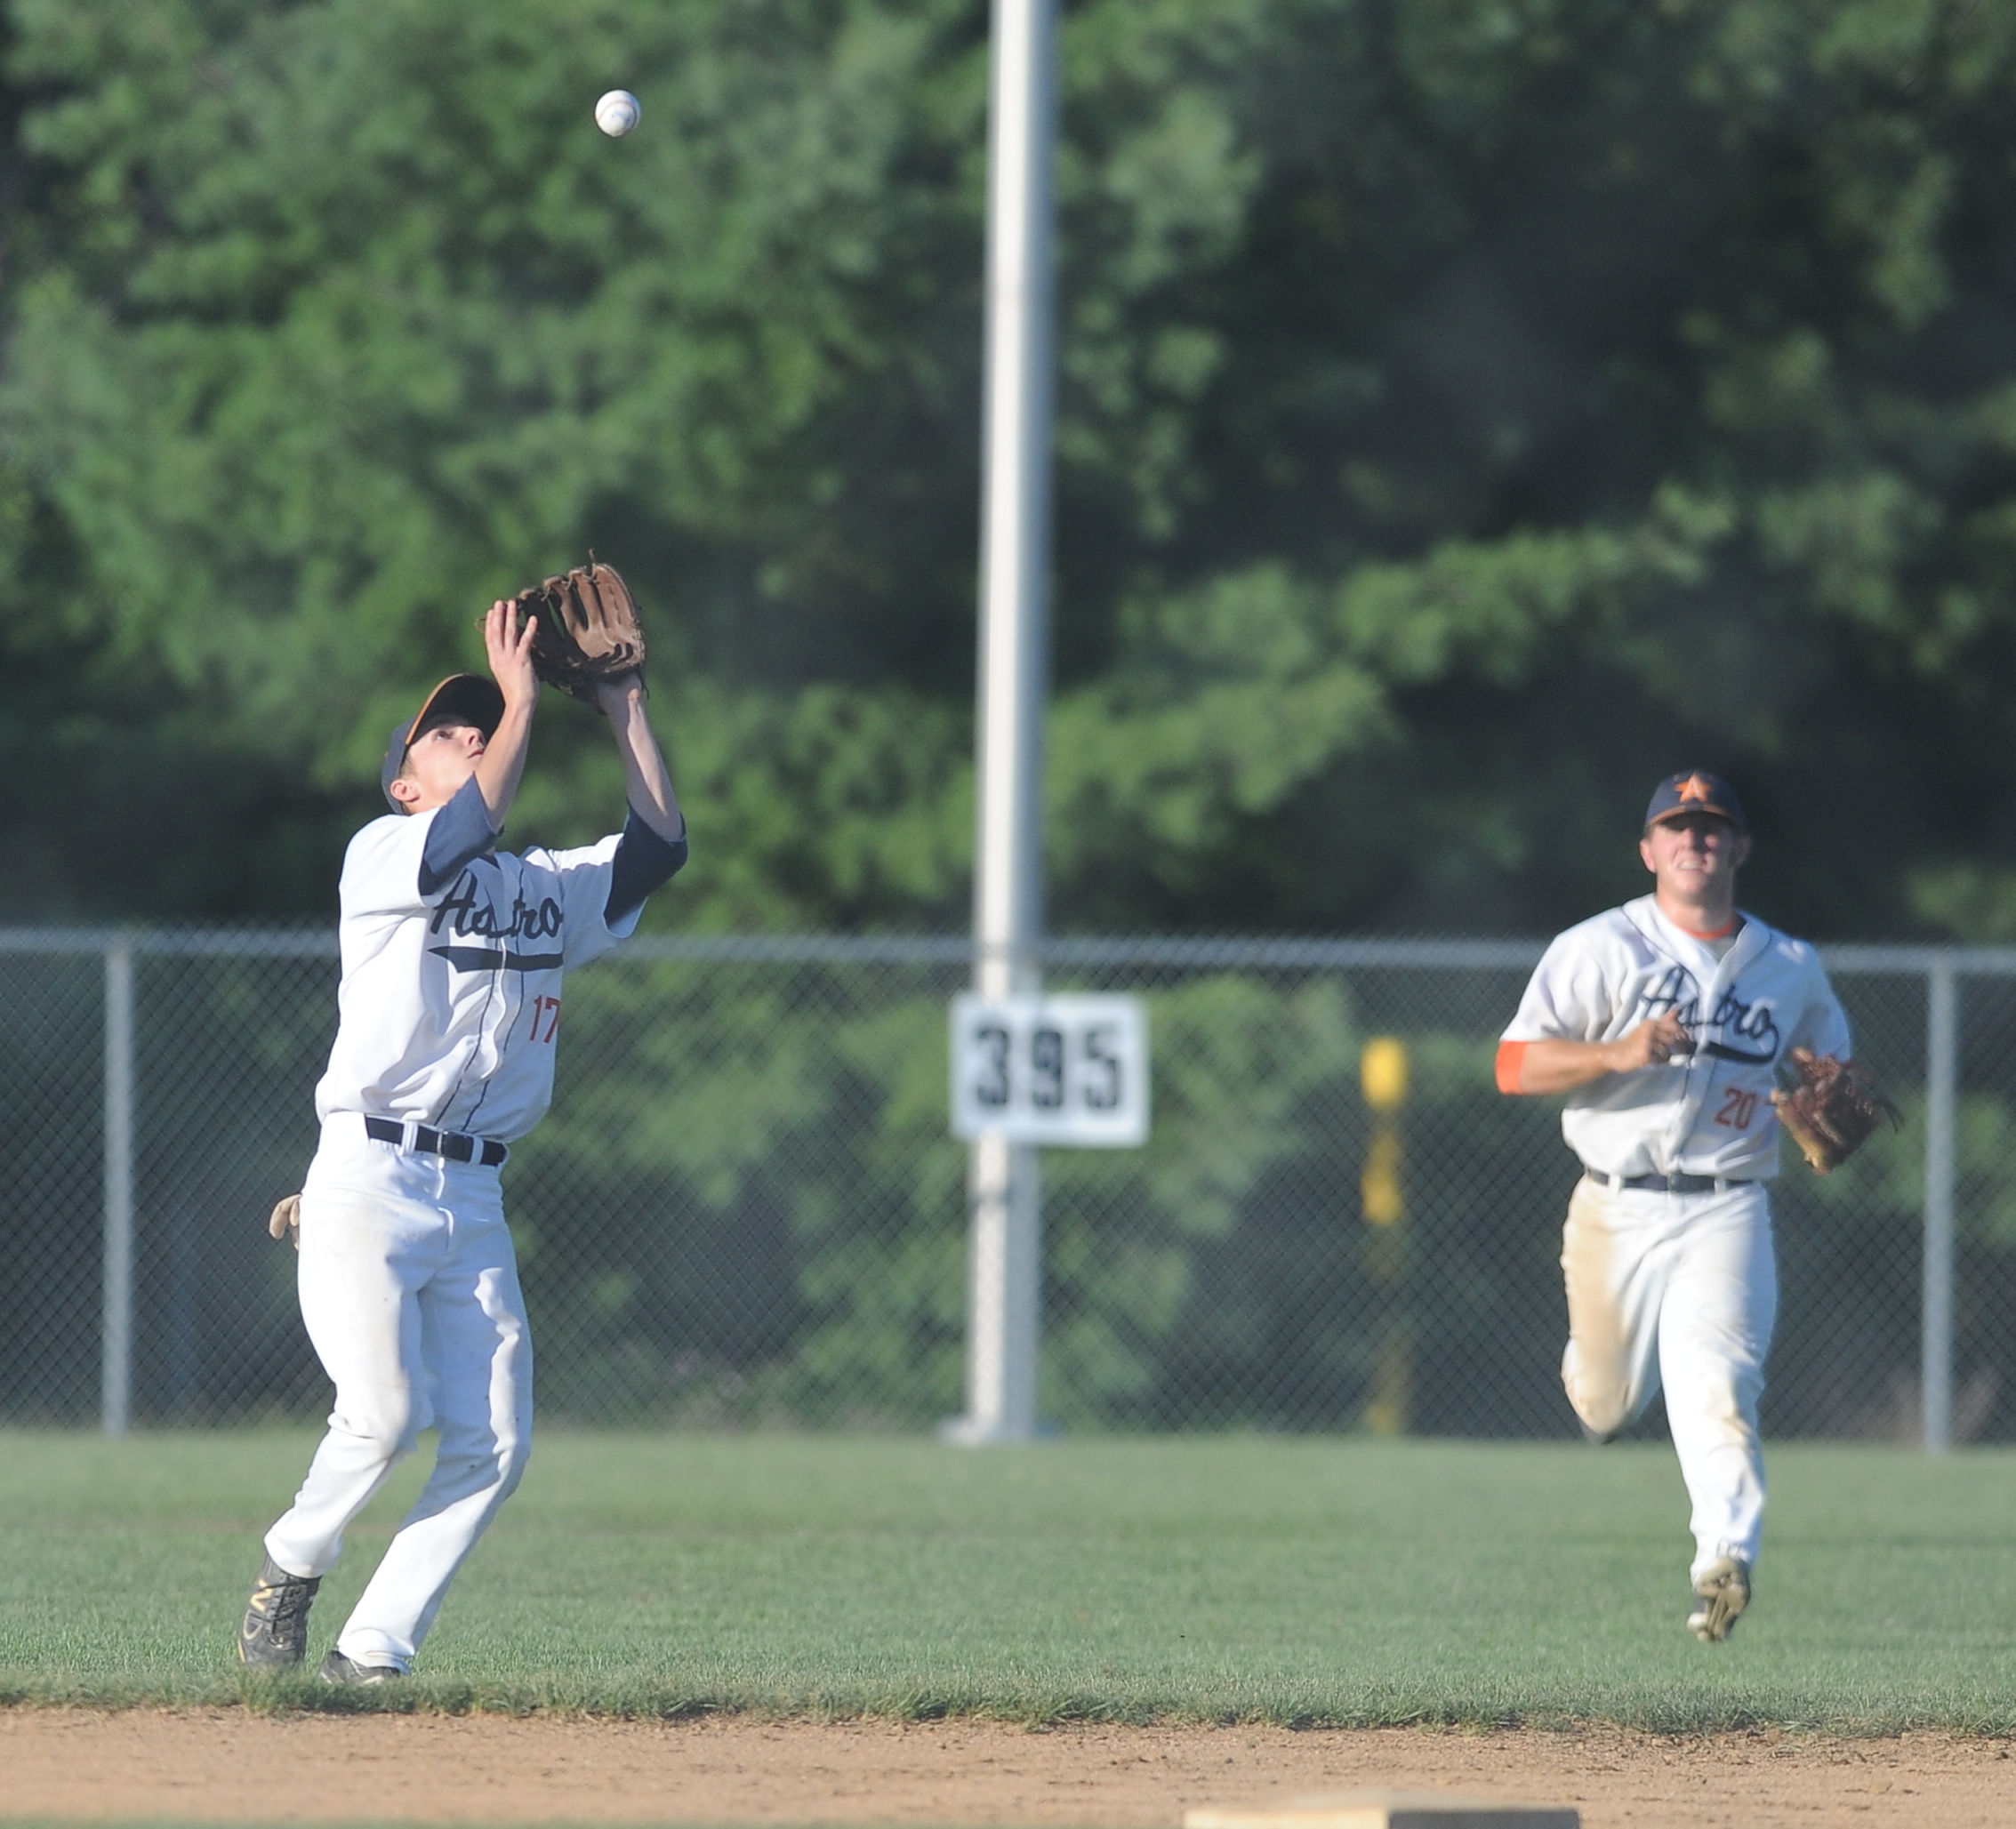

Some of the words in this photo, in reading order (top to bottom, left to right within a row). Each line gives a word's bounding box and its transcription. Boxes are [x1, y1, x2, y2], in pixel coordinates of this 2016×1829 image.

[529, 994, 561, 1044] 17
[975, 1027, 1121, 1110] 395
[1714, 1087, 1757, 1131] 20
